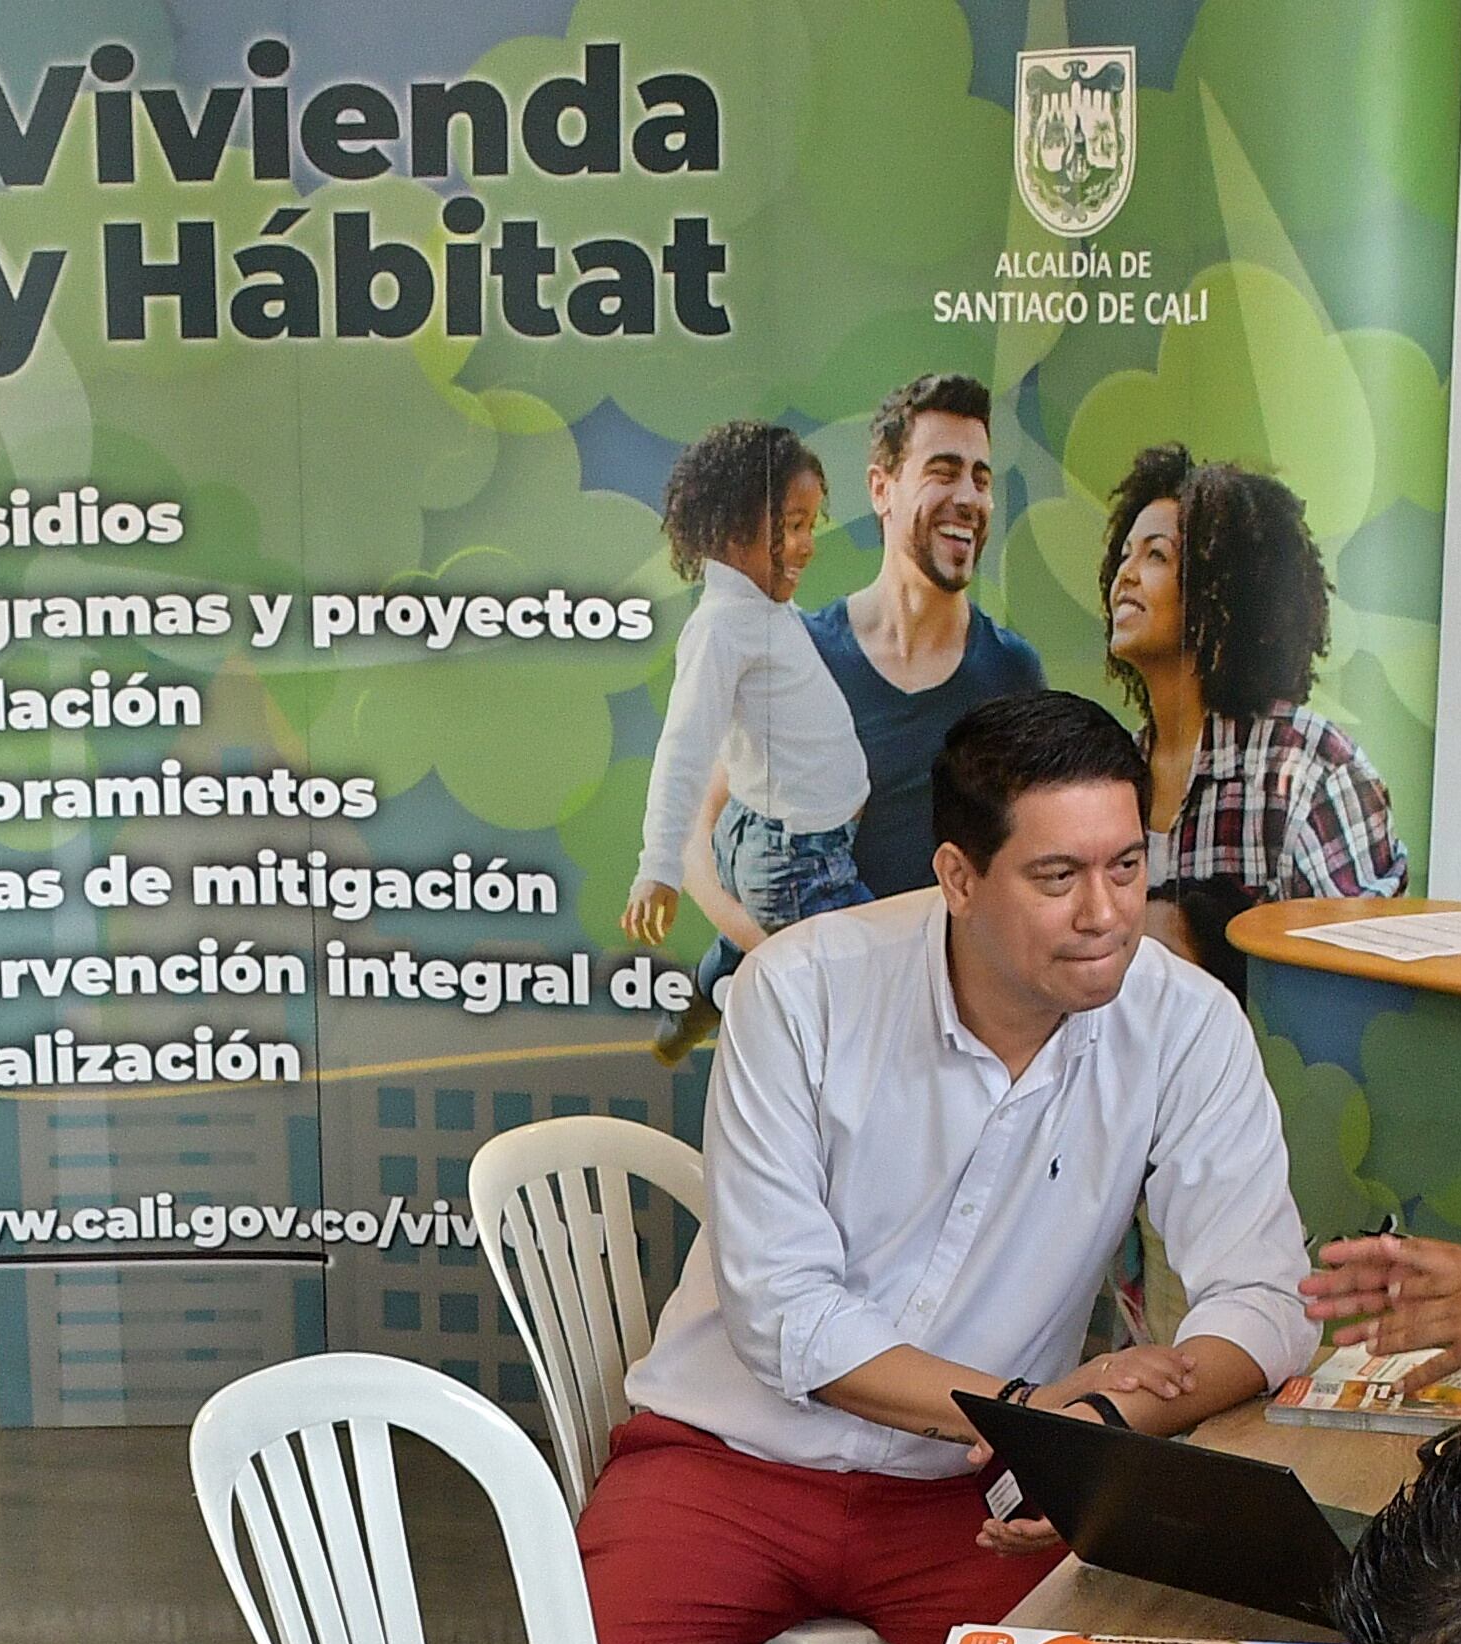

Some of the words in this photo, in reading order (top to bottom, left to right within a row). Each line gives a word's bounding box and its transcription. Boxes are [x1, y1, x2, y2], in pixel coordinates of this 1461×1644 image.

[102, 196, 732, 341] Hábitat
[994, 243, 1112, 279] ALCALDÍA
[1119, 250, 1152, 279] DE
[933, 290, 1089, 324] SANTIAGO
[1097, 291, 1136, 325] DE
[248, 594, 293, 648] y
[311, 588, 654, 650] proyectos
[83, 854, 173, 907] de
[192, 848, 558, 921] mitigación
[325, 939, 590, 1014] integral
[609, 956, 694, 1012] de
